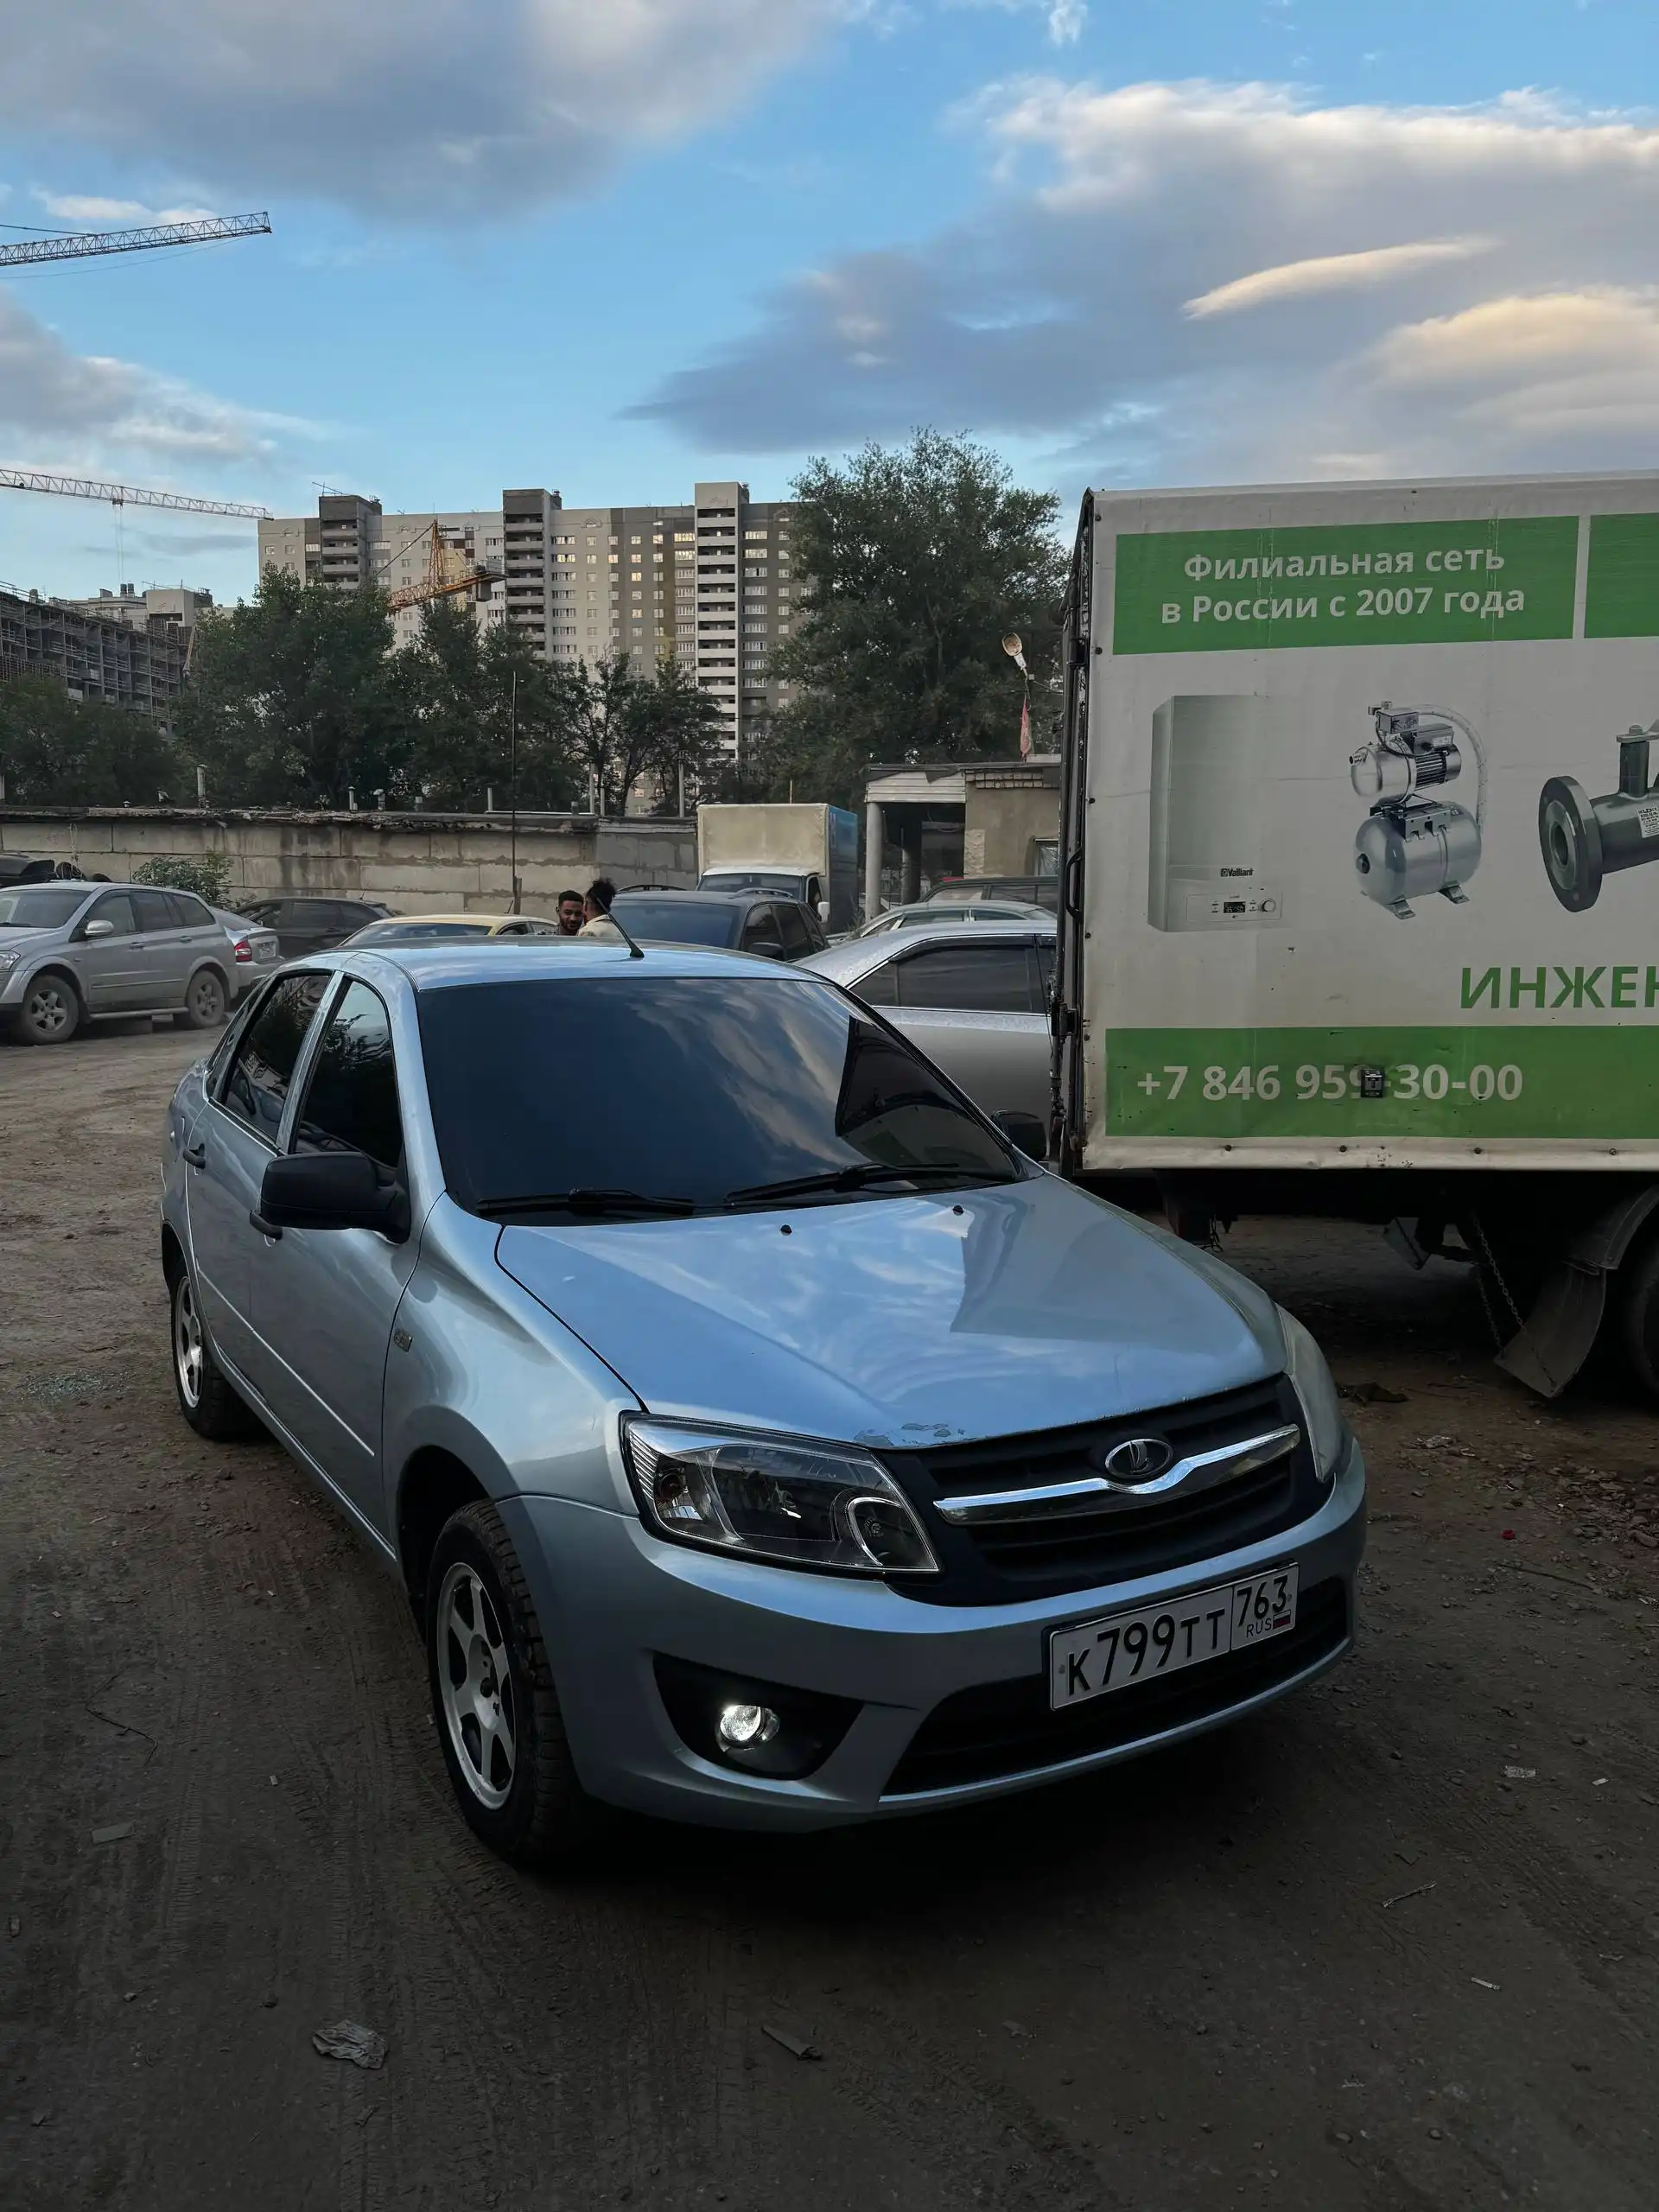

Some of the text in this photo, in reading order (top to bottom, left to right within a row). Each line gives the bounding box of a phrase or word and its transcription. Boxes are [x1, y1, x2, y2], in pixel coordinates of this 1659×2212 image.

[1185, 549, 1504, 581] Филиальная сеть
[1161, 587, 1524, 624] в России с 2007 года
[1227, 868, 1254, 877] Vaillant
[1137, 1065, 1189, 1100] +7
[1203, 1065, 1281, 1100] 846
[1236, 1575, 1288, 1627] 763
[1246, 1618, 1272, 1638] RUS
